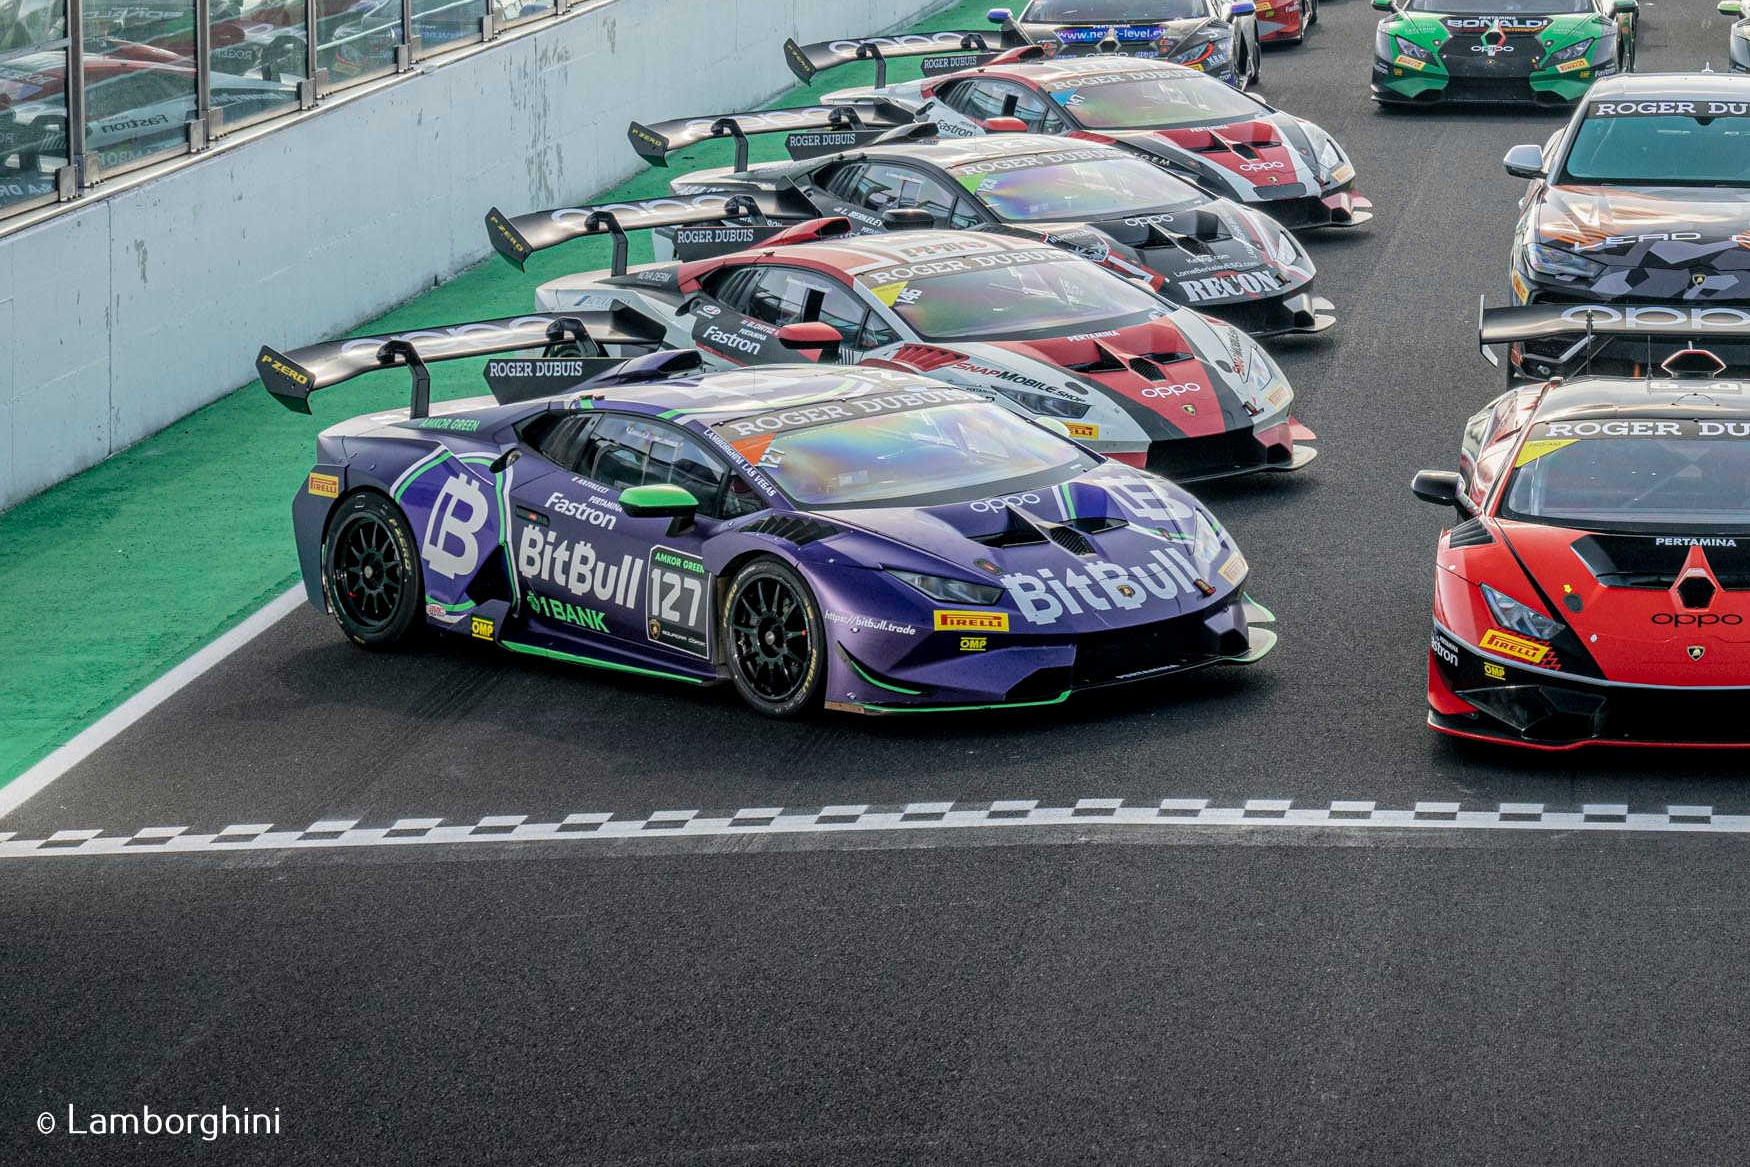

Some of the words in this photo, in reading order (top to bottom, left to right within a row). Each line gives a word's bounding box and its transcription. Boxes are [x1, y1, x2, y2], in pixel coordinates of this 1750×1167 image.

[924, 57, 948, 70] ROGER
[950, 56, 977, 69] DUBUIS
[1055, 72, 1121, 90] ROGER
[1596, 102, 1696, 117] ROGER
[937, 118, 975, 138] Fastron
[789, 135, 821, 148] ROGER
[823, 133, 856, 147] DUBUIS
[962, 154, 1038, 176] ROGER
[1239, 160, 1284, 174] oppo
[1124, 214, 1174, 228] oppo
[677, 230, 713, 244] ROGER
[715, 228, 754, 243] DUBUIS
[1573, 232, 1701, 252] LEAD
[870, 256, 968, 284] ROGER
[976, 246, 1072, 270] DUBUIS
[1178, 270, 1278, 303] RECON
[703, 325, 761, 355] Fastron
[1067, 329, 1120, 342] PERTAMINA
[262, 354, 271, 364] P
[271, 361, 308, 385] ZERO
[490, 362, 532, 378] ROGER
[535, 360, 583, 377] DUBUIS
[1141, 382, 1200, 399] oppo
[729, 403, 847, 435] ROGER
[856, 386, 979, 414] DUBUIS
[421, 417, 450, 430] AMKOR
[451, 419, 481, 433] GREEN
[1545, 420, 1682, 438] ROGER
[703, 429, 745, 465] LAMBORGHINI
[741, 462, 755, 479] LAS
[753, 474, 778, 498] VEGAS
[309, 476, 339, 494] PIRELLI
[544, 491, 618, 531] Fastron
[588, 495, 623, 514] PERTAMINA
[970, 493, 1040, 514] oppo
[1655, 537, 1737, 548] PERTAMINA
[518, 523, 645, 610] BitBull
[654, 551, 682, 567] AMKOR
[682, 559, 705, 574] GREEN
[1000, 547, 1202, 626] BitBull
[651, 568, 702, 627] 127
[471, 620, 494, 636] OMP
[824, 610, 916, 635] https://bitbull.trade
[940, 613, 1003, 629] PIRELLI
[1650, 611, 1743, 628] oppo
[960, 639, 987, 649] OMP
[1486, 635, 1545, 663] PIRELLI
[1431, 639, 1459, 668] stron
[1484, 665, 1506, 677] OMP
